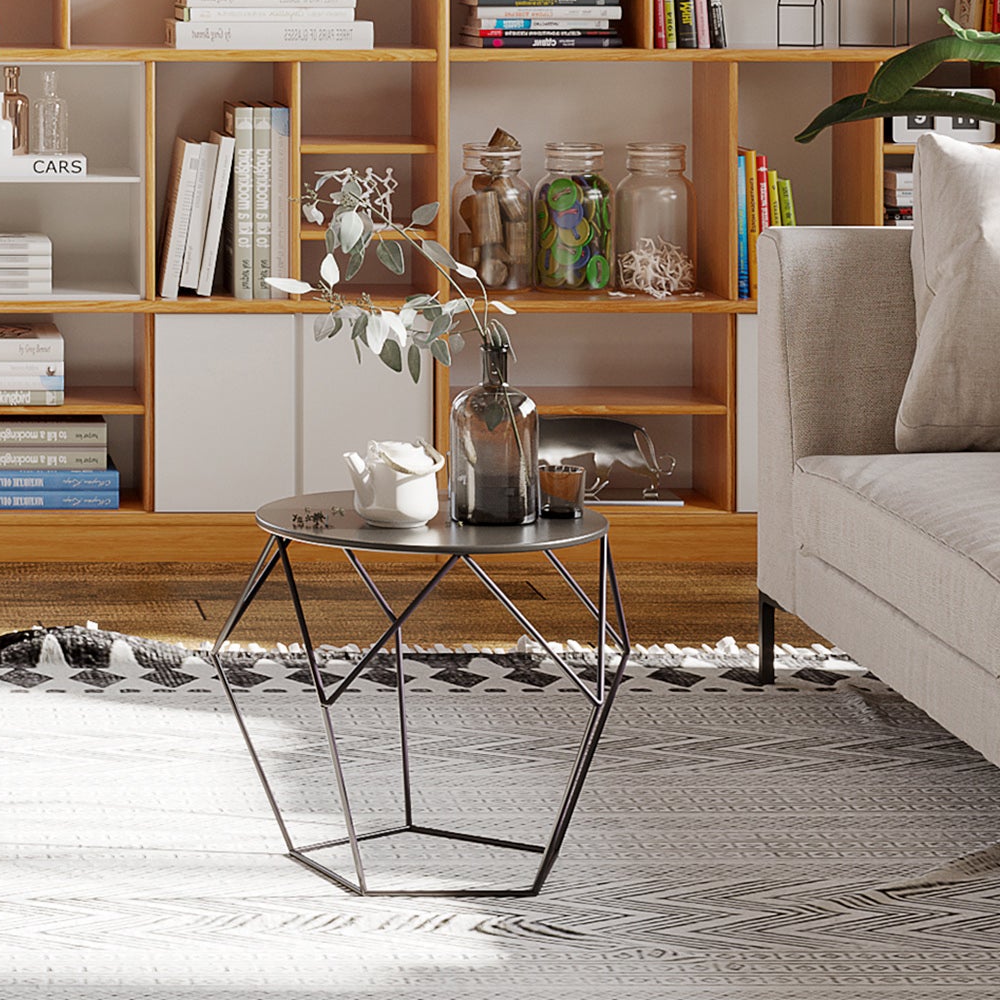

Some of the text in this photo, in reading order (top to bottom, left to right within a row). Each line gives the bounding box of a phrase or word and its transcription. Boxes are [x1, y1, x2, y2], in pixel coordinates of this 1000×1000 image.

[33, 160, 82, 174] CARS
[47, 431, 57, 441] kill
[59, 431, 67, 440] to
[47, 456, 57, 466] kill
[59, 456, 67, 465] to
